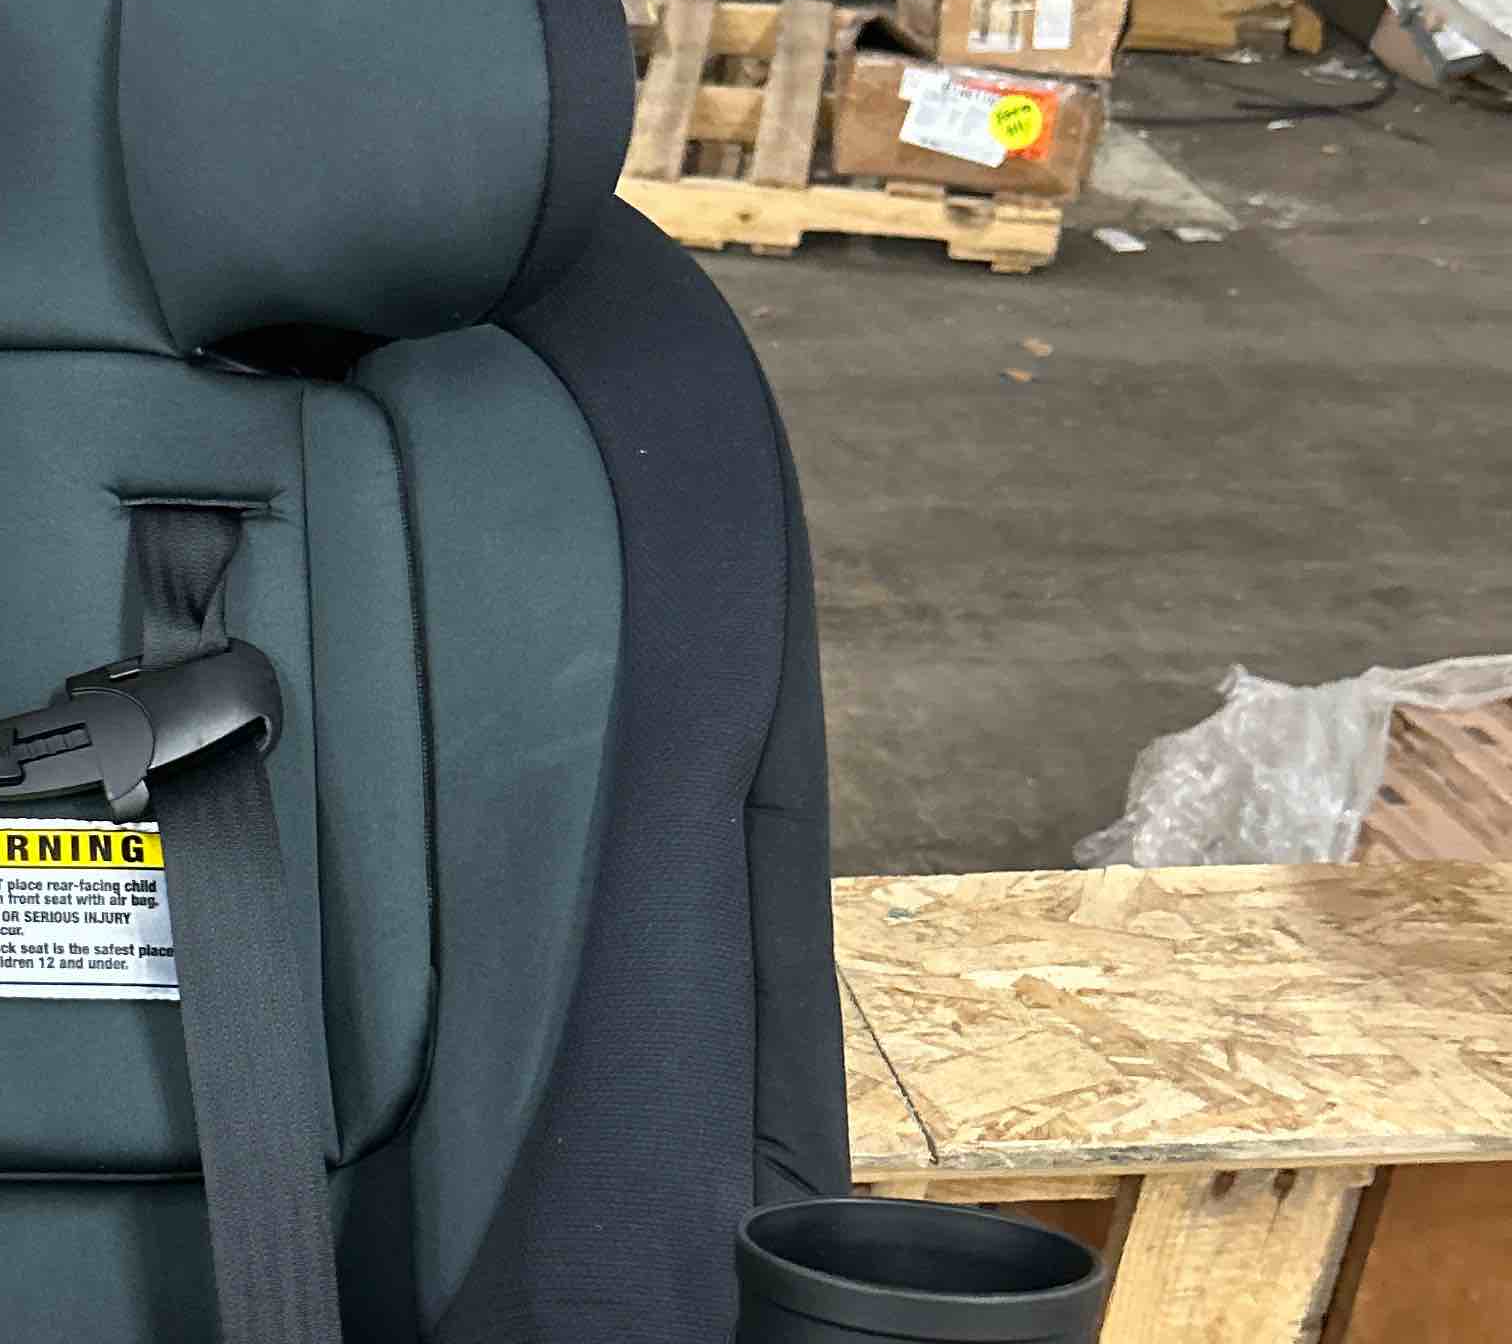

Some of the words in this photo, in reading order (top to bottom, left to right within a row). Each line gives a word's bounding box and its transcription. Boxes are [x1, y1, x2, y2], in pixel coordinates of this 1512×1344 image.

[8, 879, 42, 893] place
[47, 879, 120, 895] rear-facing
[124, 879, 157, 892] child
[8, 893, 40, 904] front
[44, 894, 72, 905] seat
[75, 894, 105, 905] with
[109, 894, 127, 906] air
[131, 894, 159, 909] bag.
[2, 910, 19, 922] OR
[24, 910, 80, 923] SERIOUS
[84, 911, 131, 924] INJURY
[20, 942, 49, 954] seat
[53, 942, 65, 954] is
[69, 942, 90, 954] the
[94, 943, 135, 956] safest
[138, 944, 175, 958] place
[38, 956, 55, 968] 12
[59, 957, 84, 969] and
[88, 958, 129, 970] under.
